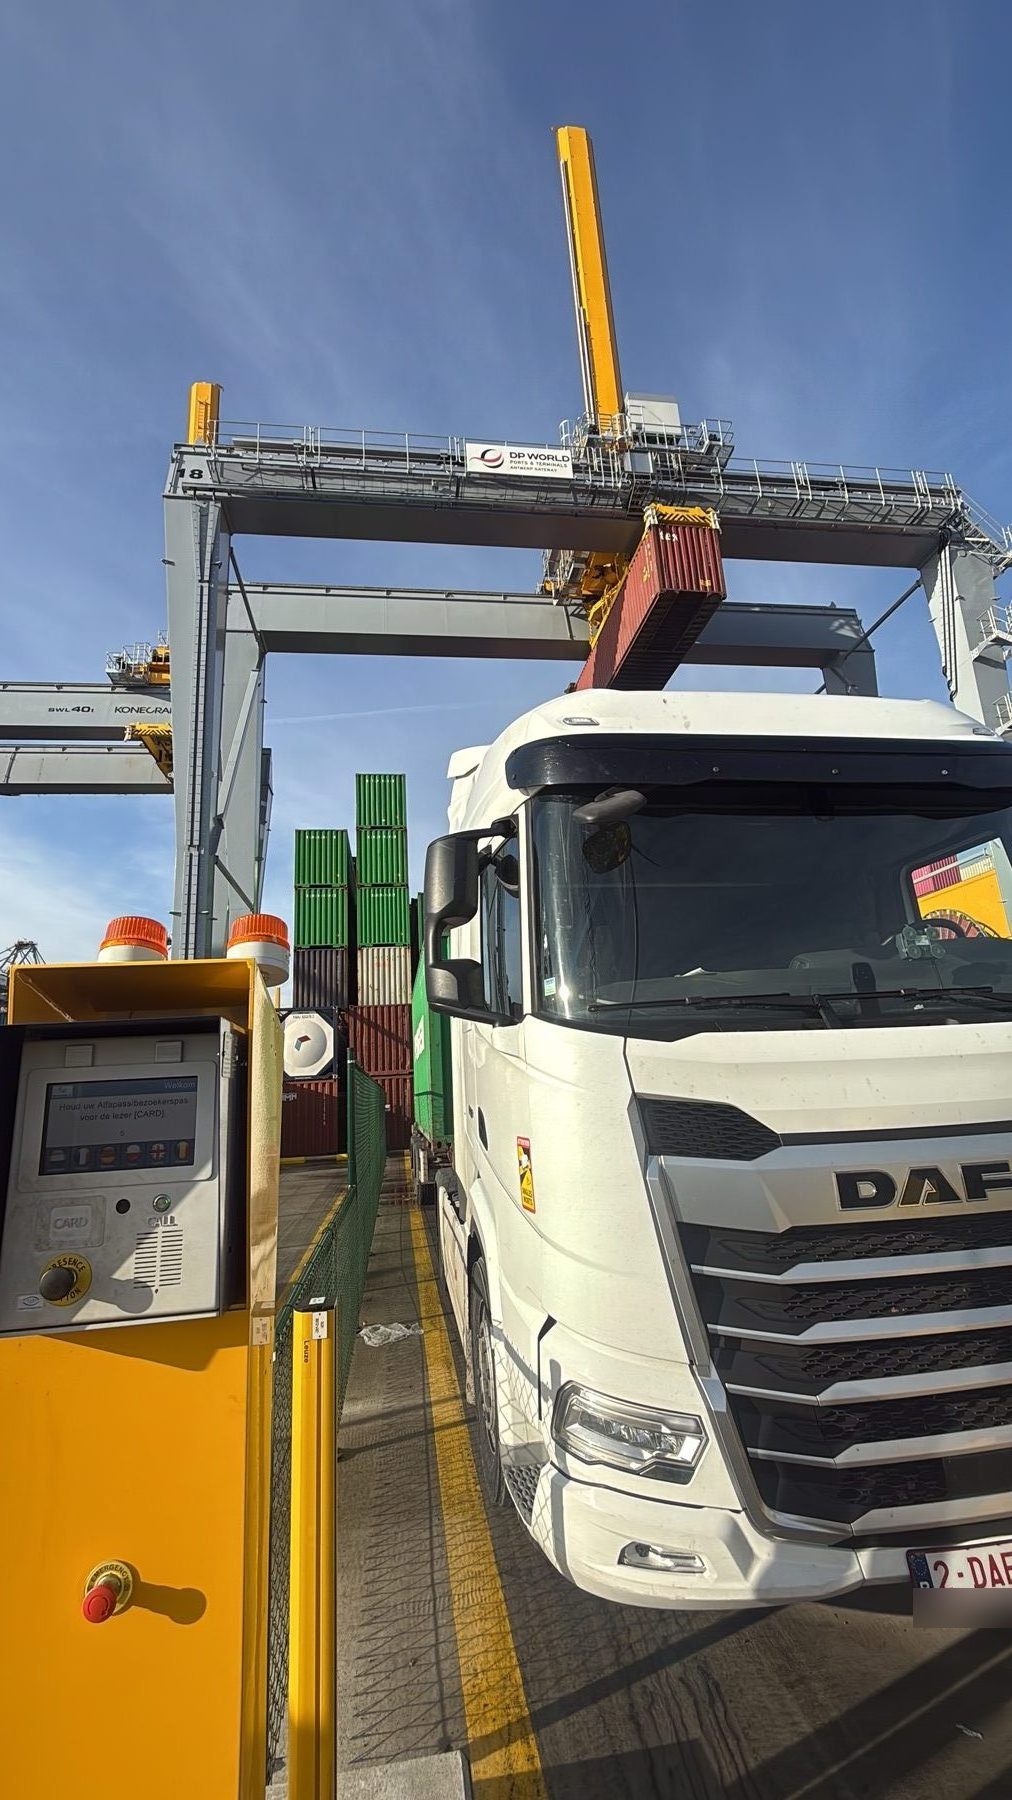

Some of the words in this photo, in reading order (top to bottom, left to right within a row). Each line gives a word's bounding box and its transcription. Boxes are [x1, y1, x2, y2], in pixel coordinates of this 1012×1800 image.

[527, 453, 570, 462] WORLD
[177, 468, 204, 479] 18
[114, 706, 172, 714] KONECRA
[832, 1160, 1012, 1211] DAF
[54, 1216, 89, 1230] CARD
[48, 1256, 86, 1272] RESENCE
